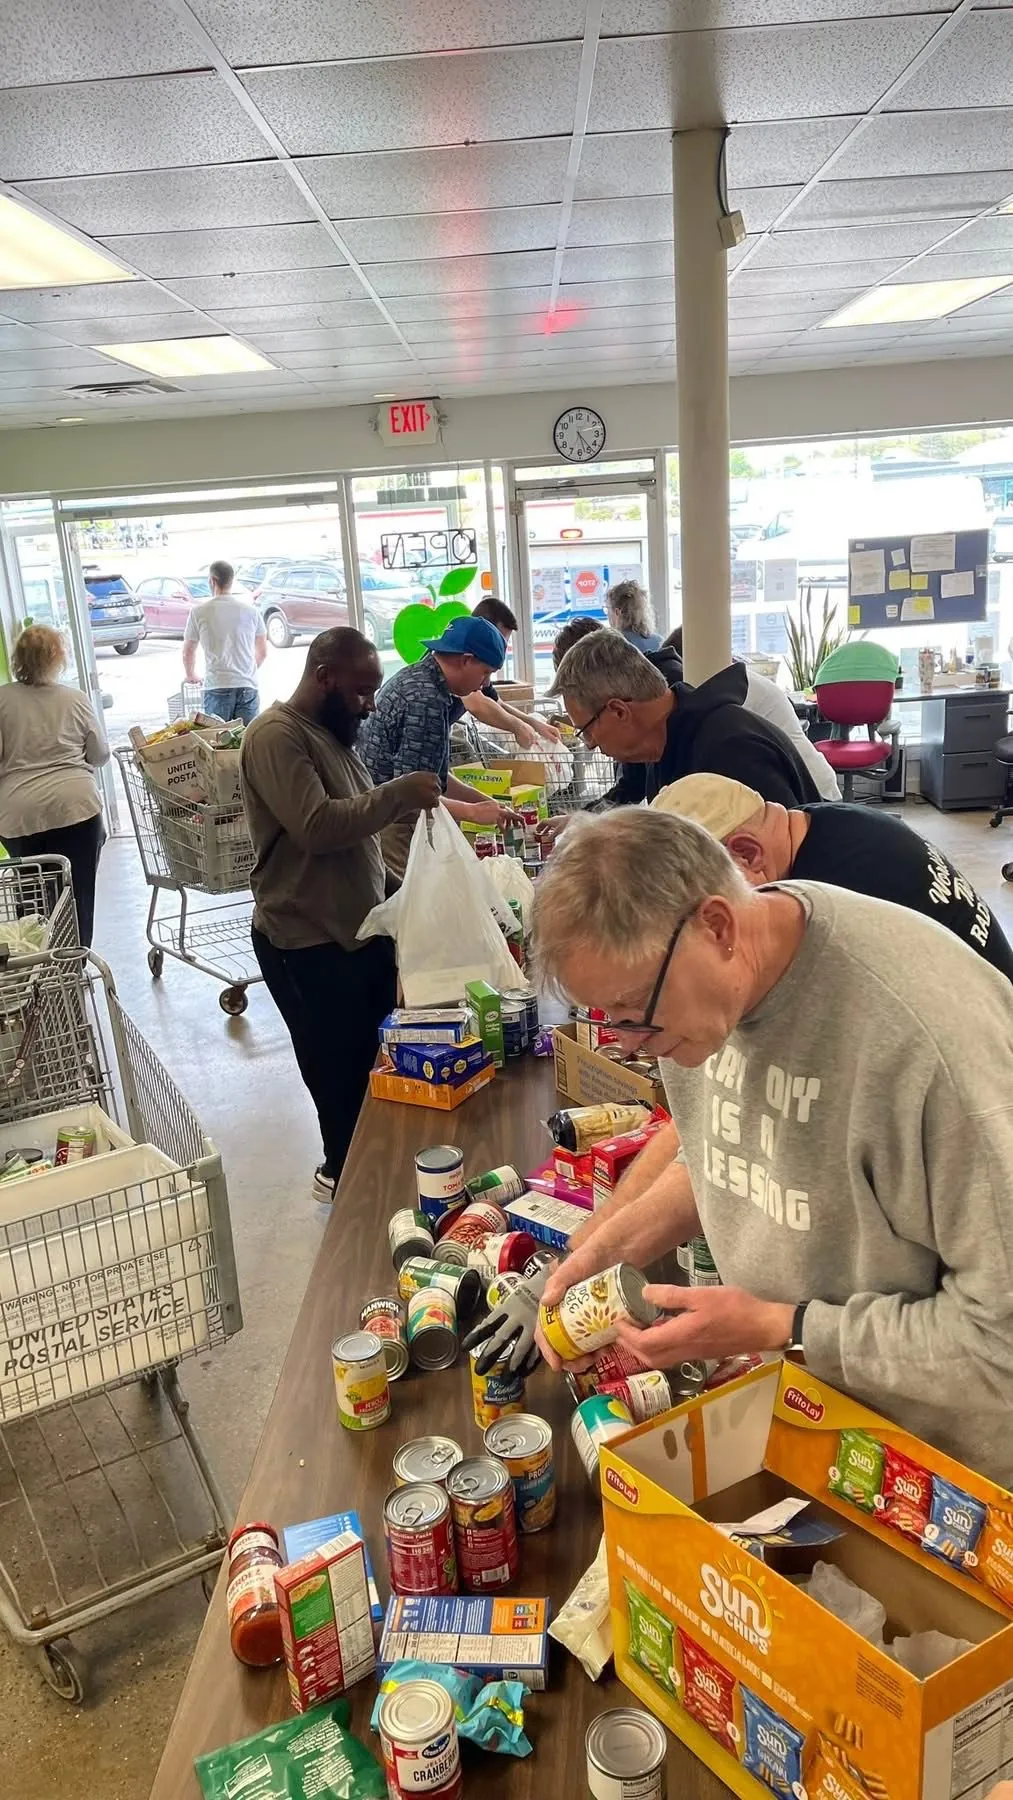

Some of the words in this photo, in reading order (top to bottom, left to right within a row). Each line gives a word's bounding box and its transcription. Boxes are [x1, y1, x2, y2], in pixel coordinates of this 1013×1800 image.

[390, 404, 425, 433] EXIT
[712, 1095, 741, 1145] IS
[760, 1114, 775, 1160] A
[5, 1289, 53, 1311] WARNING
[361, 1301, 399, 1320] MANWICH
[4, 1334, 90, 1376] POSTAL
[99, 1297, 185, 1342] SERVICE
[787, 1390, 807, 1408] Frito
[806, 1403, 821, 1420] Lay
[848, 1449, 875, 1471] Sun
[607, 1470, 624, 1490] Frito
[623, 1486, 637, 1503] Lay
[894, 1476, 923, 1500] Sun
[943, 1506, 973, 1531] Sun
[700, 1562, 773, 1639] Sun
[638, 1615, 663, 1645] Sun
[724, 1609, 769, 1656] CHIPS
[694, 1667, 721, 1700] Sun
[757, 1724, 788, 1756] Sun
